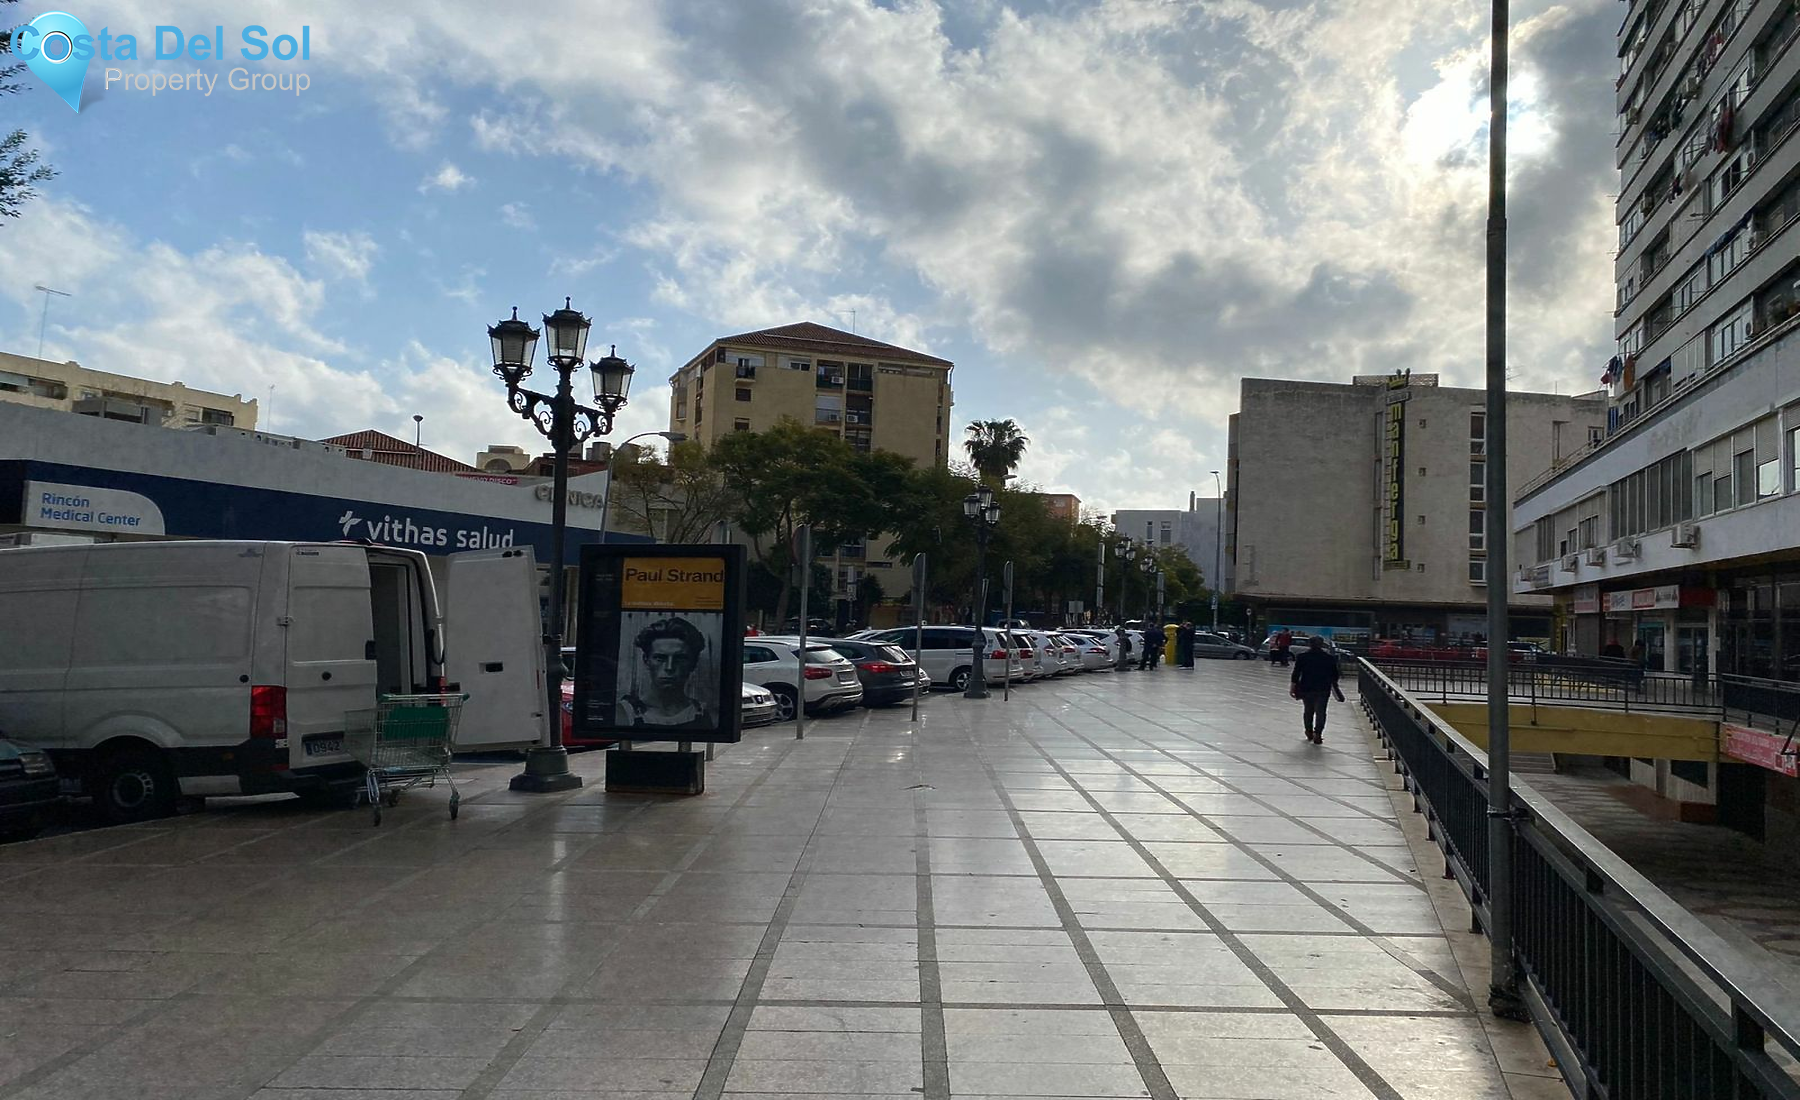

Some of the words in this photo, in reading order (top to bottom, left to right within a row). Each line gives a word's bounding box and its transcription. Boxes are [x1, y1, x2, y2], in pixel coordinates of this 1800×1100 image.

[42, 492, 90, 507] Rincón
[535, 485, 604, 509] CLNICA
[40, 507, 94, 523] Medical
[97, 512, 141, 527] Center
[367, 515, 448, 549] vithas
[456, 526, 514, 549] salud
[625, 568, 662, 582] Paul
[666, 568, 724, 583] Strand
